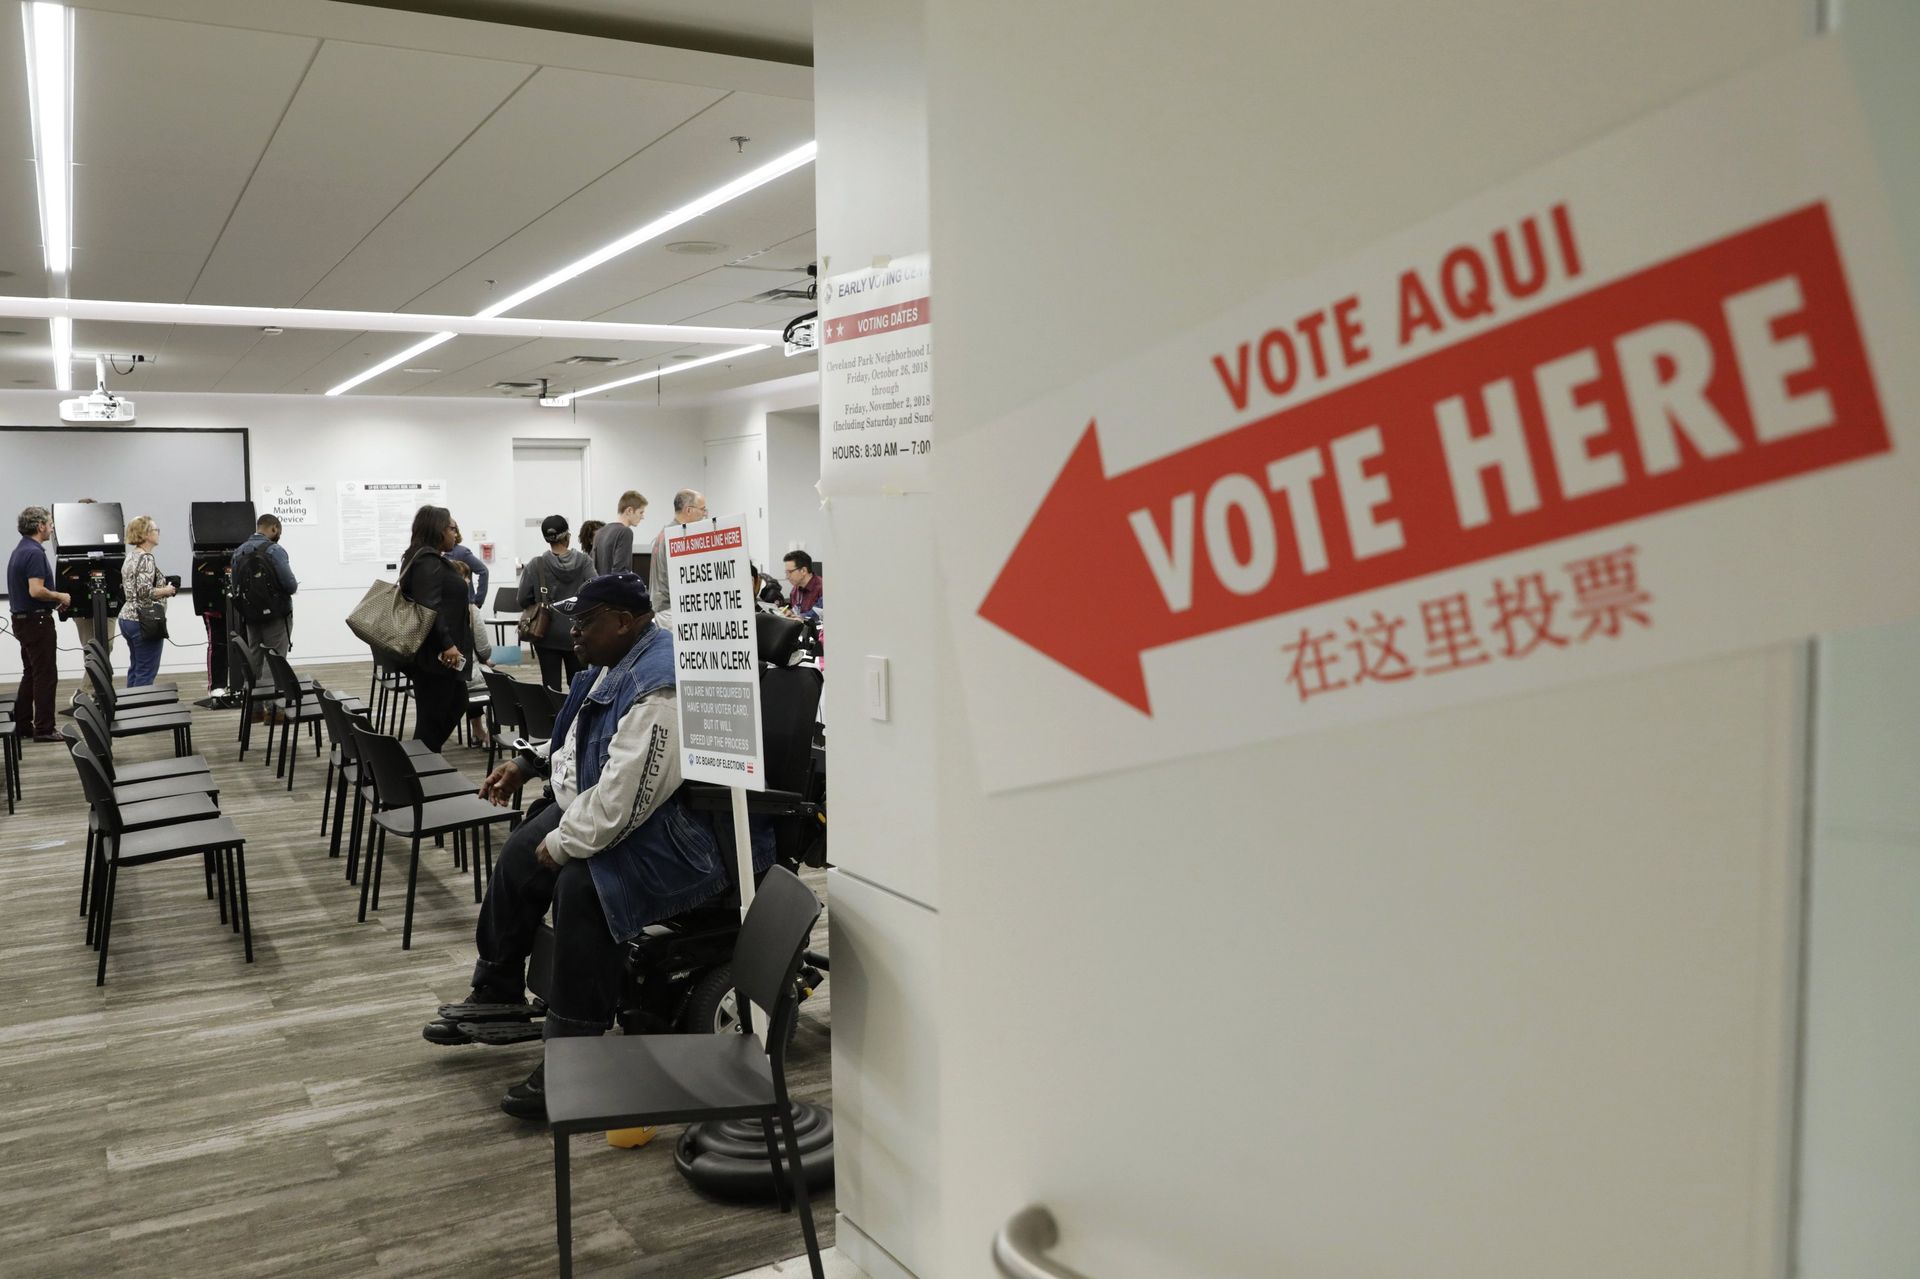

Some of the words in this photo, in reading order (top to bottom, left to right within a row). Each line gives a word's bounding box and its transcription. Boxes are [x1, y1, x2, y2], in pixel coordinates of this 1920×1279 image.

[838, 278, 867, 297] EARLY
[868, 269, 902, 289] VOTING
[1212, 296, 1371, 412] VOTE
[1399, 203, 1582, 346] AQUI
[857, 314, 889, 332] VOTING
[890, 307, 918, 327] DATES
[826, 357, 856, 372] Cleveland
[857, 354, 873, 366] Park
[875, 345, 925, 364] Neighborhood
[846, 372, 870, 384] Friday,
[872, 368, 899, 380] October
[912, 361, 929, 374] 2018
[871, 381, 900, 396] through
[844, 403, 869, 415] Friday,
[869, 398, 904, 412] November
[913, 394, 931, 407] 2018
[833, 419, 865, 432] (Including
[865, 415, 897, 428] Saturday
[899, 413, 912, 425] and
[832, 444, 863, 460] HOURS:
[865, 443, 882, 458] 8:30
[884, 442, 898, 456] AM
[911, 440, 931, 455] 7:00
[1128, 426, 1405, 613] VOTE
[1434, 275, 1836, 529] HERE
[273, 506, 306, 515] Marking
[671, 540, 685, 553] FORM
[686, 540, 691, 551] A
[691, 536, 710, 550] SINGLE
[711, 534, 723, 547] LINE
[724, 531, 740, 545] HERE
[680, 563, 712, 584] PLEASE
[714, 560, 735, 580] WAIT
[680, 594, 702, 612] HERE
[704, 592, 722, 611] FOR
[723, 590, 742, 609] THE
[678, 623, 698, 641] NEXT
[701, 620, 749, 640] AVAILABLE
[1281, 544, 1655, 704] 在这里投票
[679, 652, 708, 670] CHECK
[710, 652, 719, 669] IN
[722, 651, 751, 670] CLERK
[684, 686, 694, 696] YOU
[694, 686, 704, 696] ARE
[705, 686, 715, 697] NOT
[716, 686, 742, 698] REQUIRED
[742, 688, 750, 699] TO
[687, 702, 699, 712] HAVE
[700, 702, 714, 713] YOUR
[714, 703, 732, 714] VOTER
[704, 719, 713, 730] BUT
[714, 720, 718, 730] IT
[720, 720, 732, 731] WILL
[648, 725, 668, 776] POLO
[690, 734, 705, 745] SPEED
[706, 735, 713, 746] UP
[714, 736, 723, 747] THE
[696, 755, 701, 764] DC
[702, 756, 715, 767] BOARD
[716, 758, 721, 767] OF
[722, 759, 745, 771] ELECTIONS
